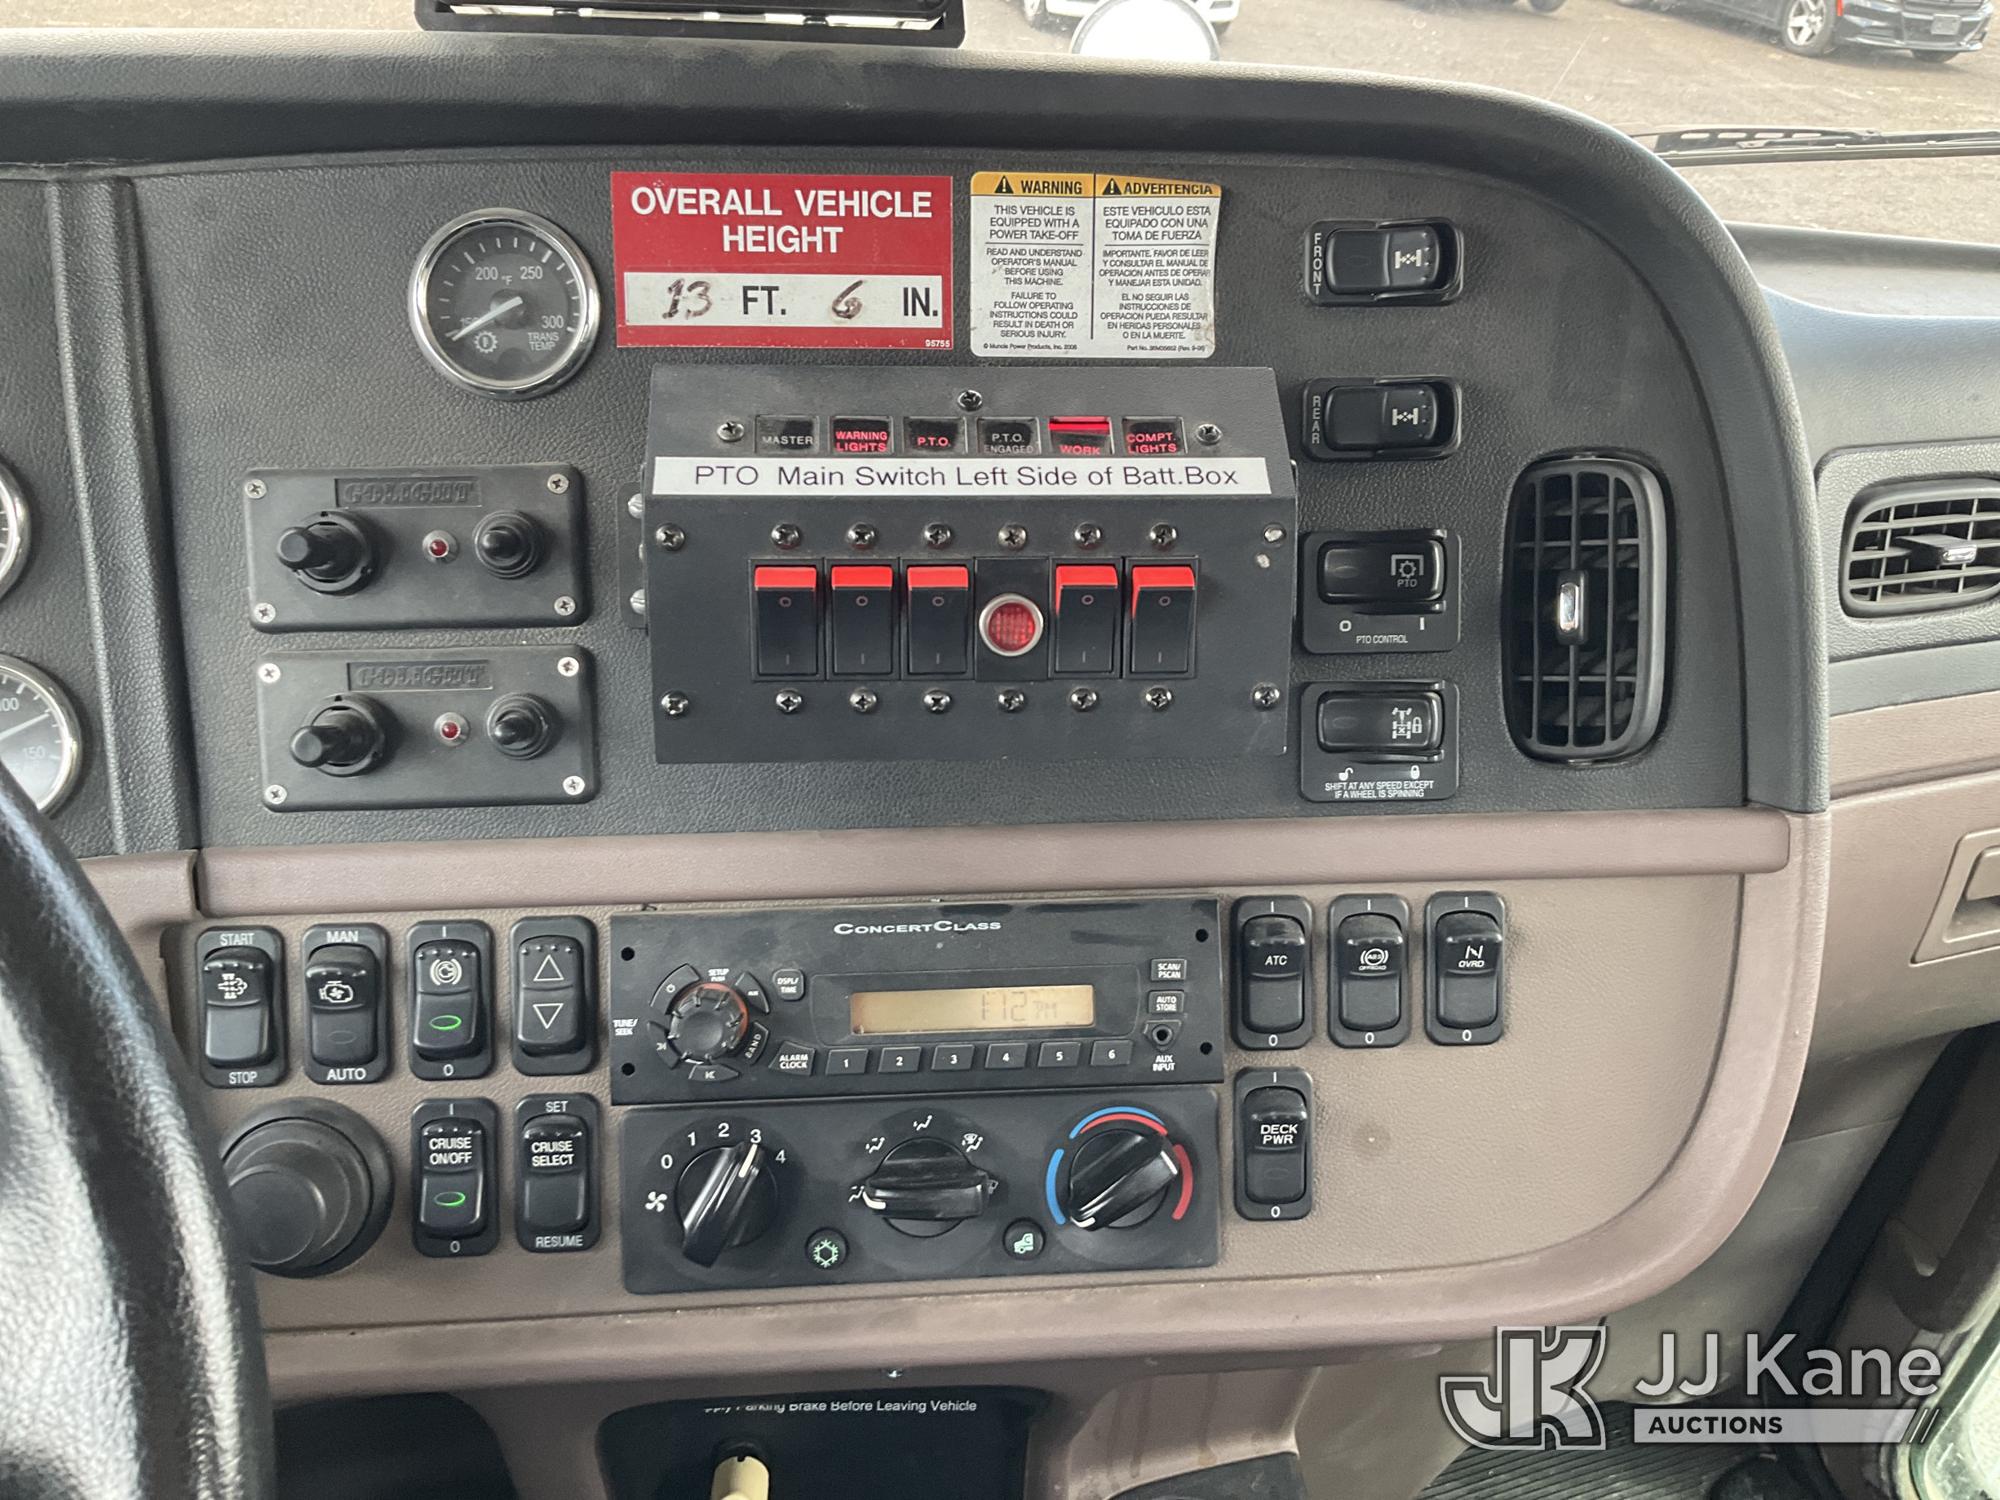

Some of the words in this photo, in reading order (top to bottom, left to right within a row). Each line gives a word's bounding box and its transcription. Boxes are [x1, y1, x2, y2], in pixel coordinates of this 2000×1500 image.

[1021, 180, 1082, 195] WARNING
[1124, 182, 1213, 195] ADVERTENCIA
[631, 186, 783, 215] OVERALL
[794, 189, 933, 218] VEHICLE
[994, 205, 1018, 215] THIS
[1020, 205, 1063, 216] VEHICLE
[1065, 206, 1075, 216] IS
[1103, 206, 1129, 216] ESTE
[1131, 206, 1184, 216] VEHICULO
[1186, 206, 1211, 216] ESTA
[990, 217, 1042, 227] EQUIPPED
[1044, 218, 1070, 228] WITH
[1072, 218, 1080, 228] A
[1105, 218, 1159, 228] EQUIPADO
[1161, 218, 1184, 228] CON
[1187, 218, 1209, 228] UNA
[722, 225, 843, 253] HEIGHT
[989, 229, 1027, 239] POWER
[1030, 230, 1079, 240] TAKE-OFF
[1112, 231, 1143, 240] TOMA
[1145, 231, 1158, 240] DE
[1161, 230, 1202, 240] FUERZA
[986, 248, 1008, 256] READ
[1010, 248, 1027, 256] AND
[1028, 249, 1083, 257] UNDERSTAND
[991, 257, 1041, 266] OPERATOR'S
[1043, 258, 1077, 266] MANUAL
[1312, 232, 1322, 295] FRONT
[475, 267, 499, 281] 200
[520, 266, 543, 280] 250
[1005, 268, 1036, 276] BEFORE
[1038, 268, 1063, 276] USING
[1004, 277, 1022, 285] THIS
[662, 278, 713, 320] 13
[742, 286, 786, 316] FT.
[831, 280, 868, 320] 6
[903, 287, 938, 317] IN.
[1011, 292, 1044, 300] FAILURE
[1046, 292, 1057, 300] TO
[1121, 293, 1130, 301] EL
[994, 301, 1027, 309] FOLLOW
[989, 311, 1048, 319] INSTRUCTIONS
[541, 315, 564, 329] 300
[1062, 321, 1074, 329] OR
[527, 332, 560, 341] TRANS
[1000, 330, 1035, 338] SERIOUS
[529, 341, 556, 351] TEMP
[925, 339, 950, 348] 95755
[1311, 395, 1321, 444] REAR
[762, 436, 814, 445] MASTER
[836, 431, 888, 441] WARNING
[1126, 432, 1176, 442] COMPT.
[836, 442, 887, 452] LIGHTS
[983, 445, 1034, 453] ENGAGED
[1059, 444, 1101, 455] WORK
[1128, 443, 1178, 454] LIGHTS
[695, 465, 759, 486] PTO
[778, 465, 844, 486] Main
[855, 465, 946, 486] Switch
[956, 465, 1008, 486] Left
[1016, 465, 1078, 486] Side
[1088, 465, 1113, 486] of
[1123, 465, 1239, 486] Batt.Box
[1397, 578, 1418, 588] PTO
[1356, 635, 1372, 644] PTO
[1372, 635, 1409, 644] CONTROL
[23, 745, 45, 760] 150
[1325, 782, 1347, 791] SHIFT
[1349, 782, 1359, 790] AT
[1359, 781, 1375, 790] ANY
[1376, 781, 1402, 789] SPEED
[1404, 780, 1434, 789] EXCEPT
[1335, 790, 1342, 799] IF
[1349, 790, 1376, 798] WHEEL
[1378, 790, 1387, 798] IS
[1388, 789, 1424, 798] SPINNING
[220, 933, 254, 946] START
[326, 931, 359, 943] MAN
[1265, 955, 1288, 966] ATC
[1458, 960, 1485, 968] OVRD
[1158, 971, 1181, 979] PSCAN
[780, 985, 797, 993] TIME
[1156, 996, 1177, 1004] AUTO
[1156, 1003, 1177, 1011] STORE
[615, 1027, 633, 1036] SEEK
[745, 1033, 762, 1059] BAND
[779, 1054, 809, 1062] ALARM
[950, 1054, 958, 1064] 3
[1002, 1053, 1010, 1062] 4
[1056, 1051, 1063, 1061] 5
[1108, 1050, 1116, 1059] 6
[1155, 1055, 1173, 1063] AUX
[780, 1061, 807, 1069] CLOCK
[843, 1058, 849, 1068] 1
[896, 1056, 904, 1066] 2
[1153, 1063, 1175, 1072] INPUT
[229, 1071, 258, 1085] STOP
[327, 1068, 367, 1081] AUTO
[546, 1100, 568, 1113] SET
[718, 1122, 730, 1137] 2
[1260, 1124, 1298, 1135] DECK
[687, 1131, 696, 1146] 1
[750, 1128, 762, 1143] 3
[1262, 1134, 1294, 1145] PWR
[429, 1137, 472, 1149] CRUISE
[531, 1140, 573, 1153] CRUISE
[430, 1151, 472, 1165] ON/OFF
[532, 1154, 574, 1167] SELECT
[775, 1149, 786, 1163] 4
[661, 1154, 673, 1169] 0
[535, 1235, 583, 1248] RESUME
[830, 1401, 873, 1412] Before
[876, 1400, 927, 1413] Leaving
[930, 1400, 977, 1412] Vehicle
